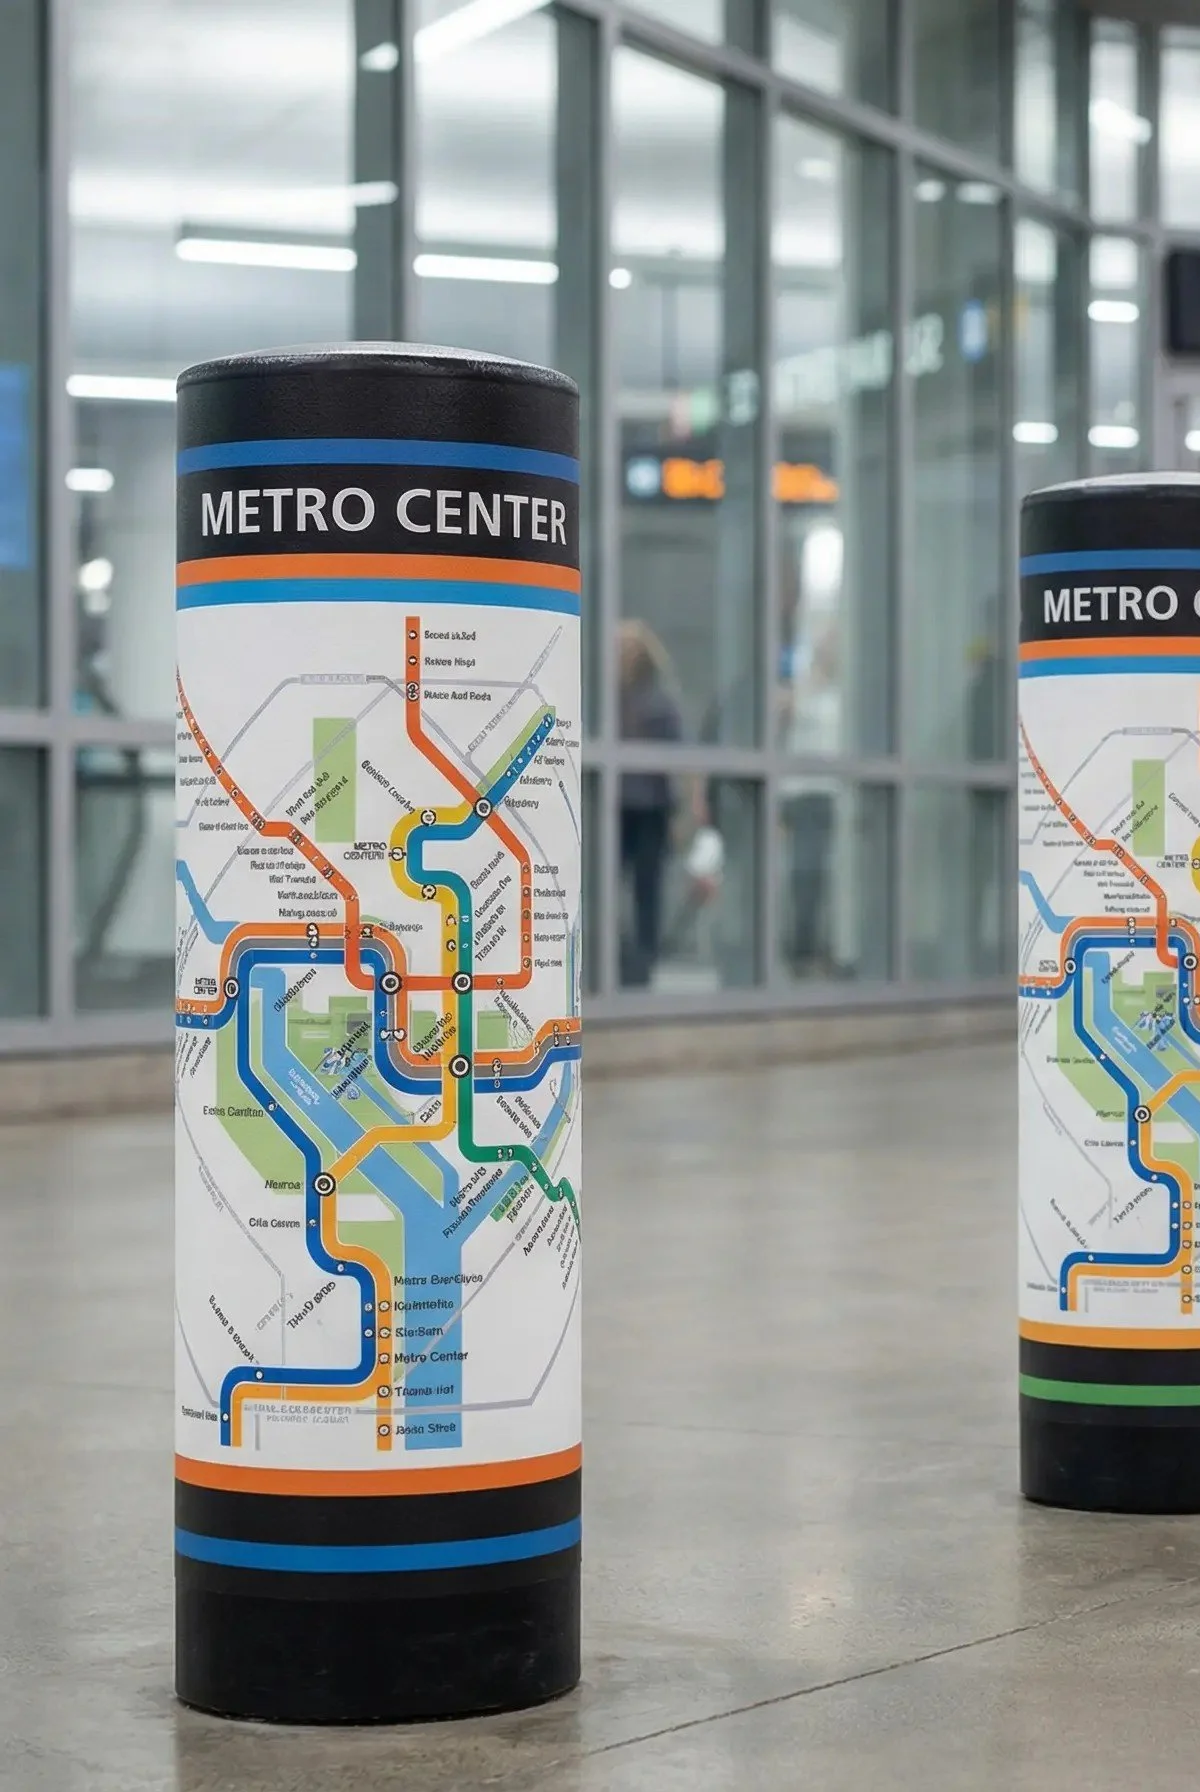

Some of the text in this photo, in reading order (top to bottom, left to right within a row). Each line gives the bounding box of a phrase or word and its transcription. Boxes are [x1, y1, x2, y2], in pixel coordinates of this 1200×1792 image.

[202, 487, 567, 545] METRO CENTER
[1044, 585, 1178, 624] METRO
